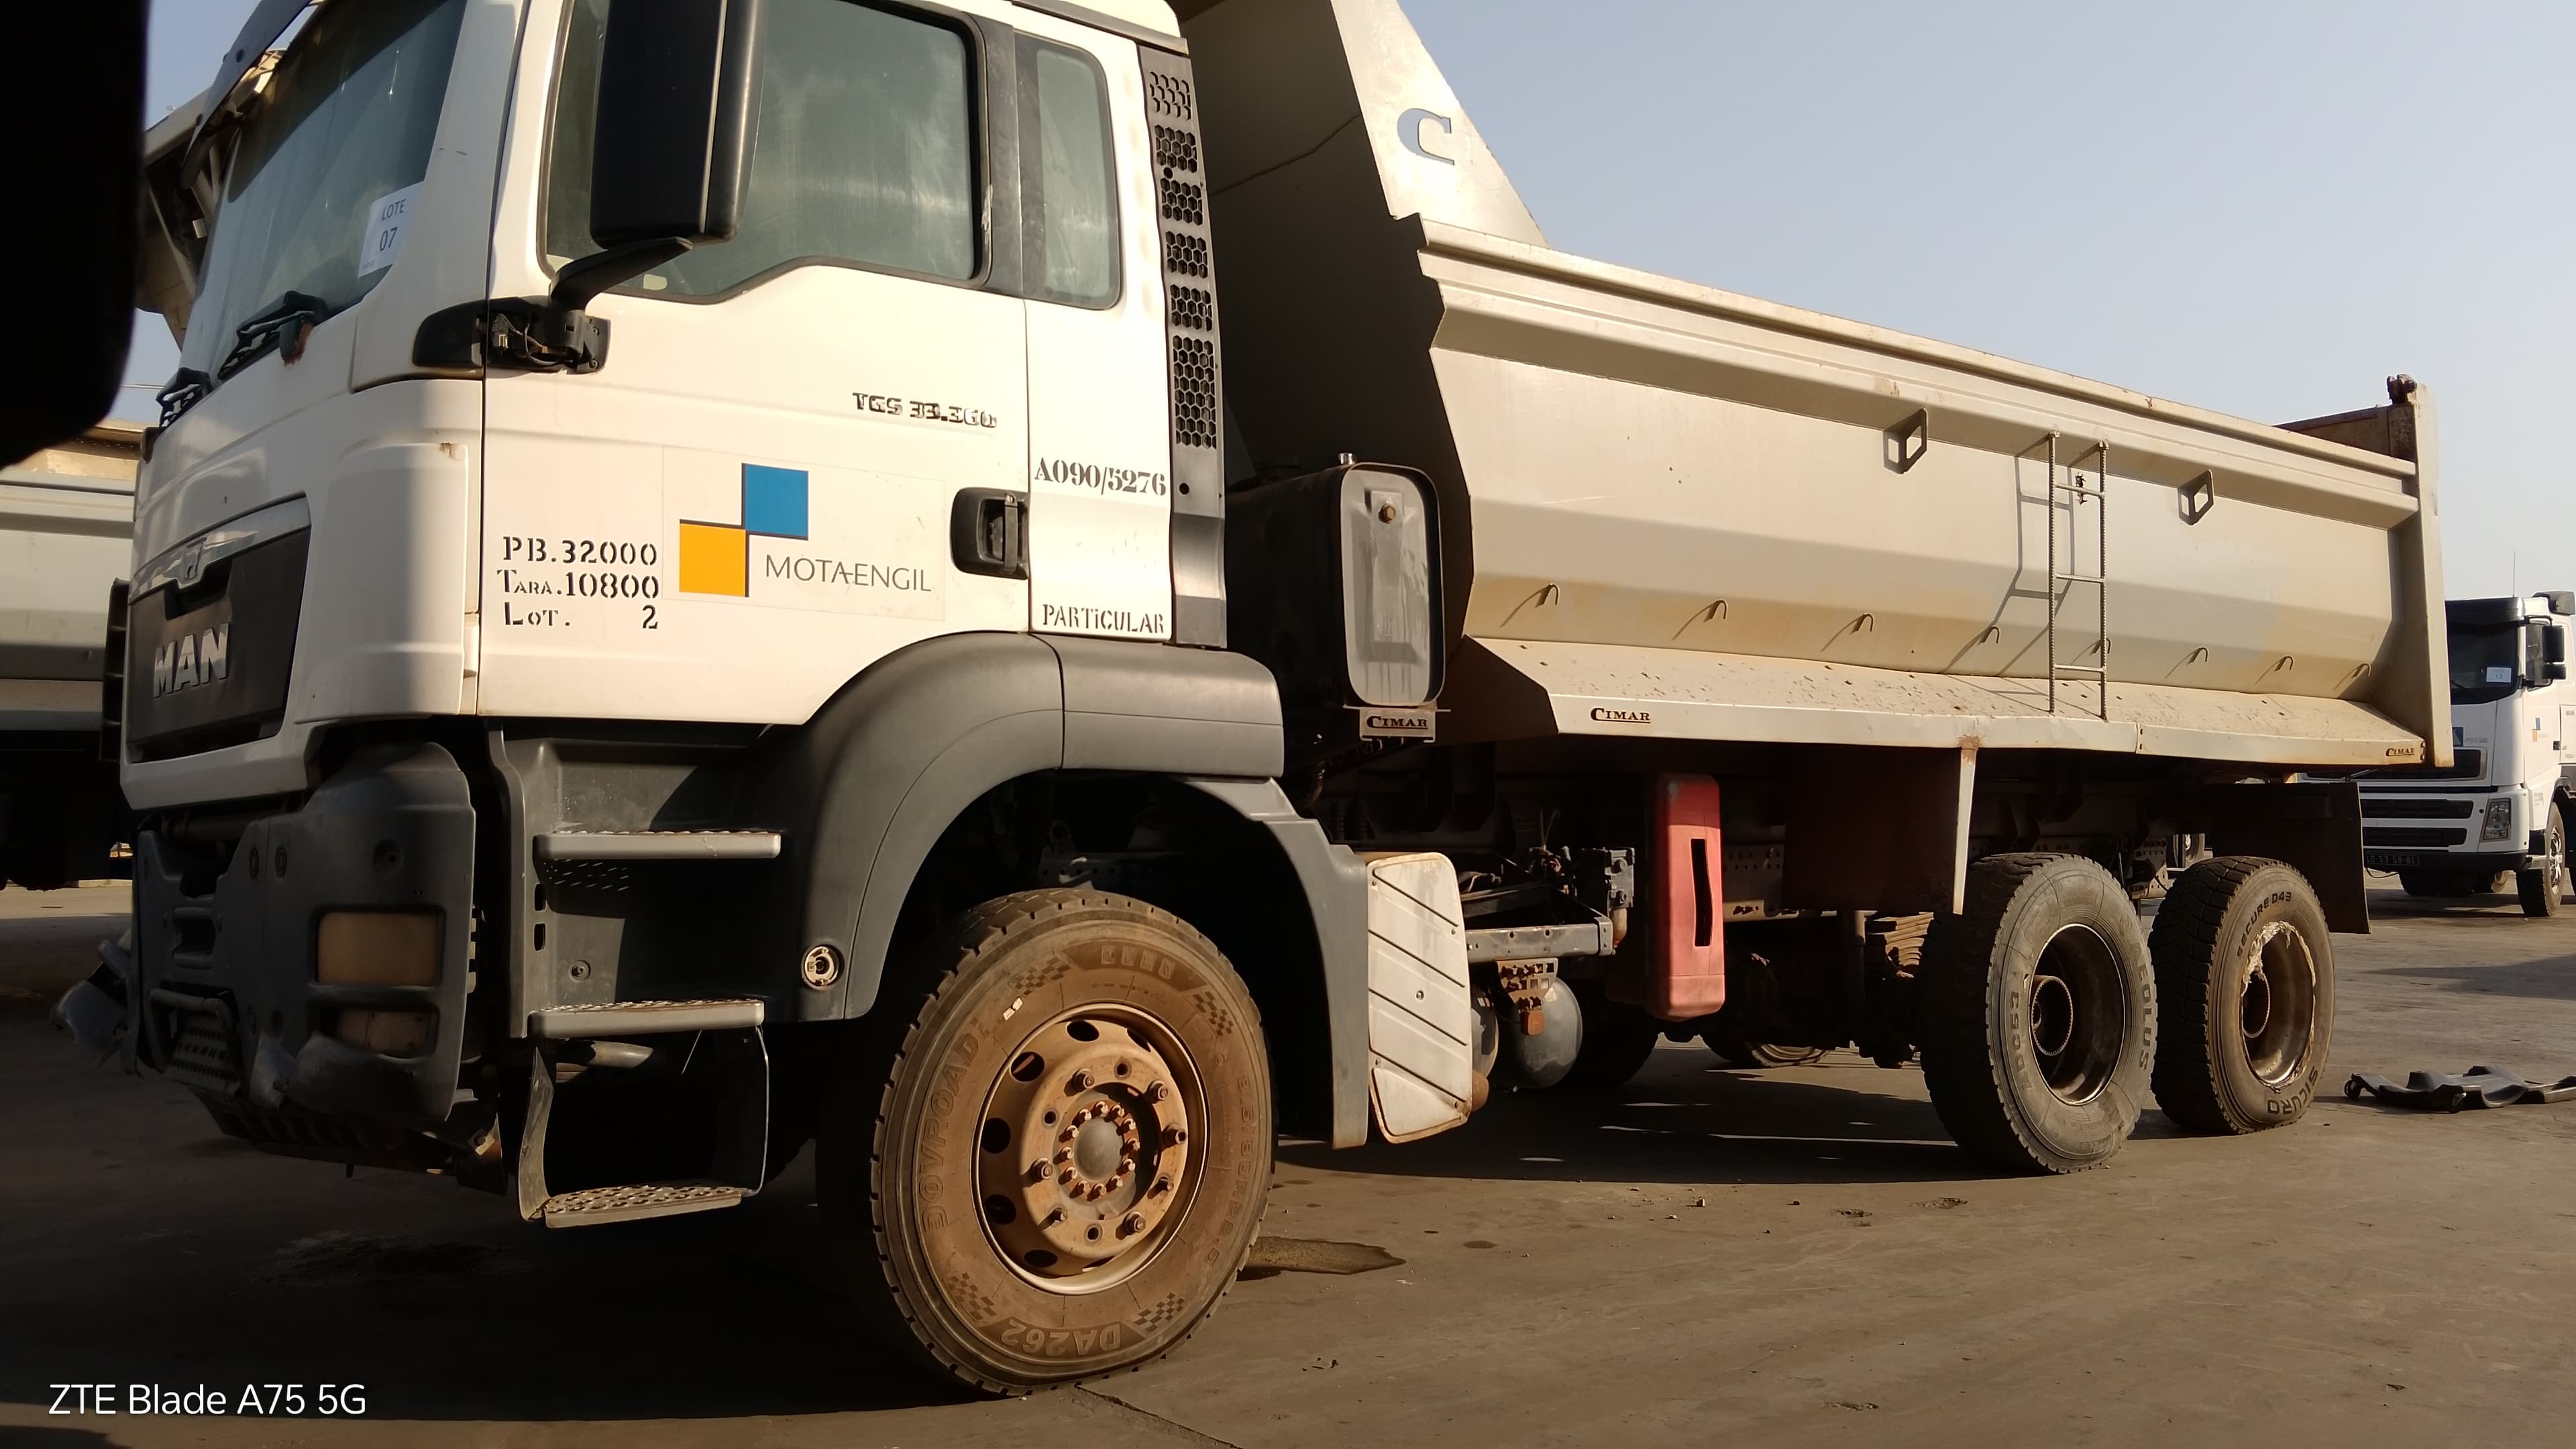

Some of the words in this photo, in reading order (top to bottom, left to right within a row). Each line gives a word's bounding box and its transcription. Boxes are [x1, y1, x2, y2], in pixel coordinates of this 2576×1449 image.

[1397, 108, 1455, 166] C
[381, 199, 406, 221] LOTE
[380, 226, 398, 252] 07
[853, 392, 903, 416] TGS
[910, 400, 998, 428] 33.360
[1034, 457, 1167, 496] A090/5276
[503, 536, 657, 566] PB.32000
[642, 604, 659, 629] 2
[152, 622, 230, 699] MAN
[2271, 891, 2292, 904] D43
[1001, 1320, 1122, 1356] DA262
